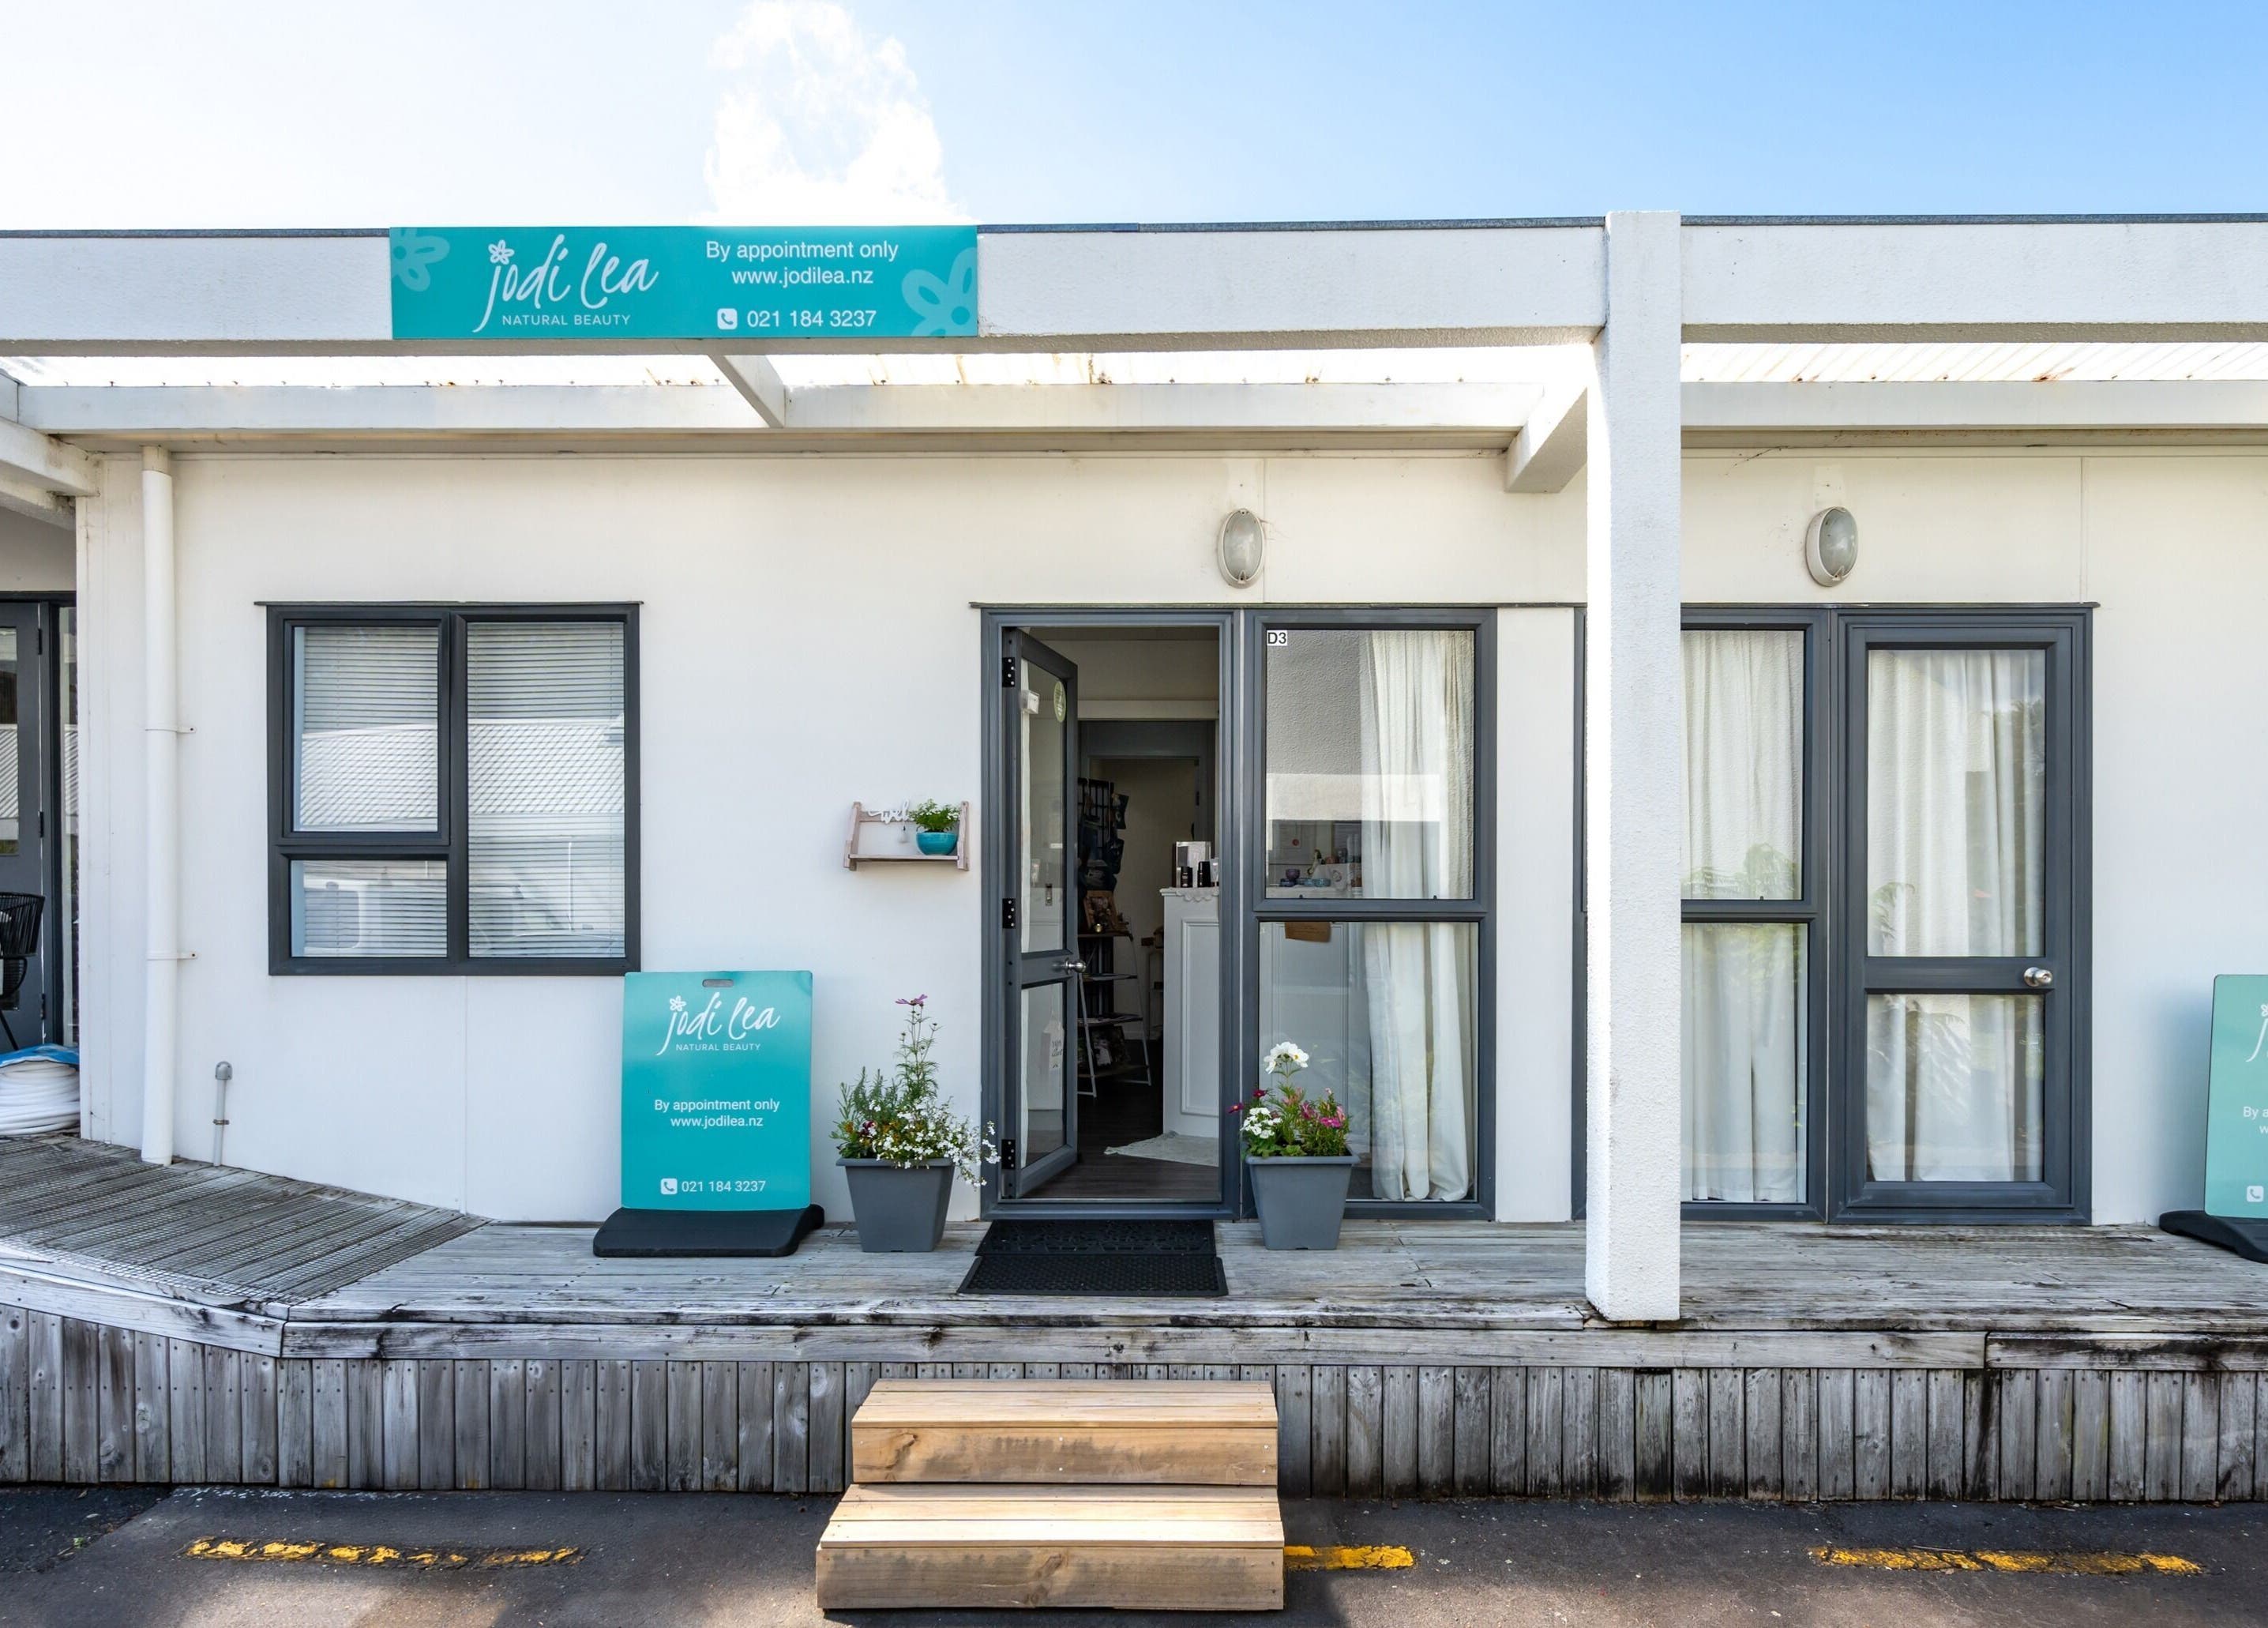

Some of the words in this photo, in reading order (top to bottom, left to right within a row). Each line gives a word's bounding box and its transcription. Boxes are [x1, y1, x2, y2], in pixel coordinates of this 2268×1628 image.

[706, 241, 730, 262] By
[737, 241, 854, 262] appointment
[859, 240, 899, 262] only
[472, 234, 571, 333] jodi
[580, 243, 659, 309] lea
[731, 267, 874, 288] www.jodilea.nz
[501, 314, 568, 325] NATURAL
[574, 314, 631, 325] BEAUTY
[747, 310, 780, 327] 021
[790, 310, 823, 327] 184
[830, 310, 877, 327] 3237
[1267, 632, 1286, 644] D3
[655, 992, 722, 1055] jodi
[728, 997, 781, 1040] lea
[654, 1099, 670, 1111] By
[673, 1099, 751, 1112] appointment
[754, 1099, 780, 1112] only
[2243, 1106, 2259, 1120] By
[670, 1115, 764, 1129] www.jodilea.nz
[682, 1180, 704, 1193] 021
[709, 1180, 731, 1192] 184
[734, 1180, 766, 1192] 3237
